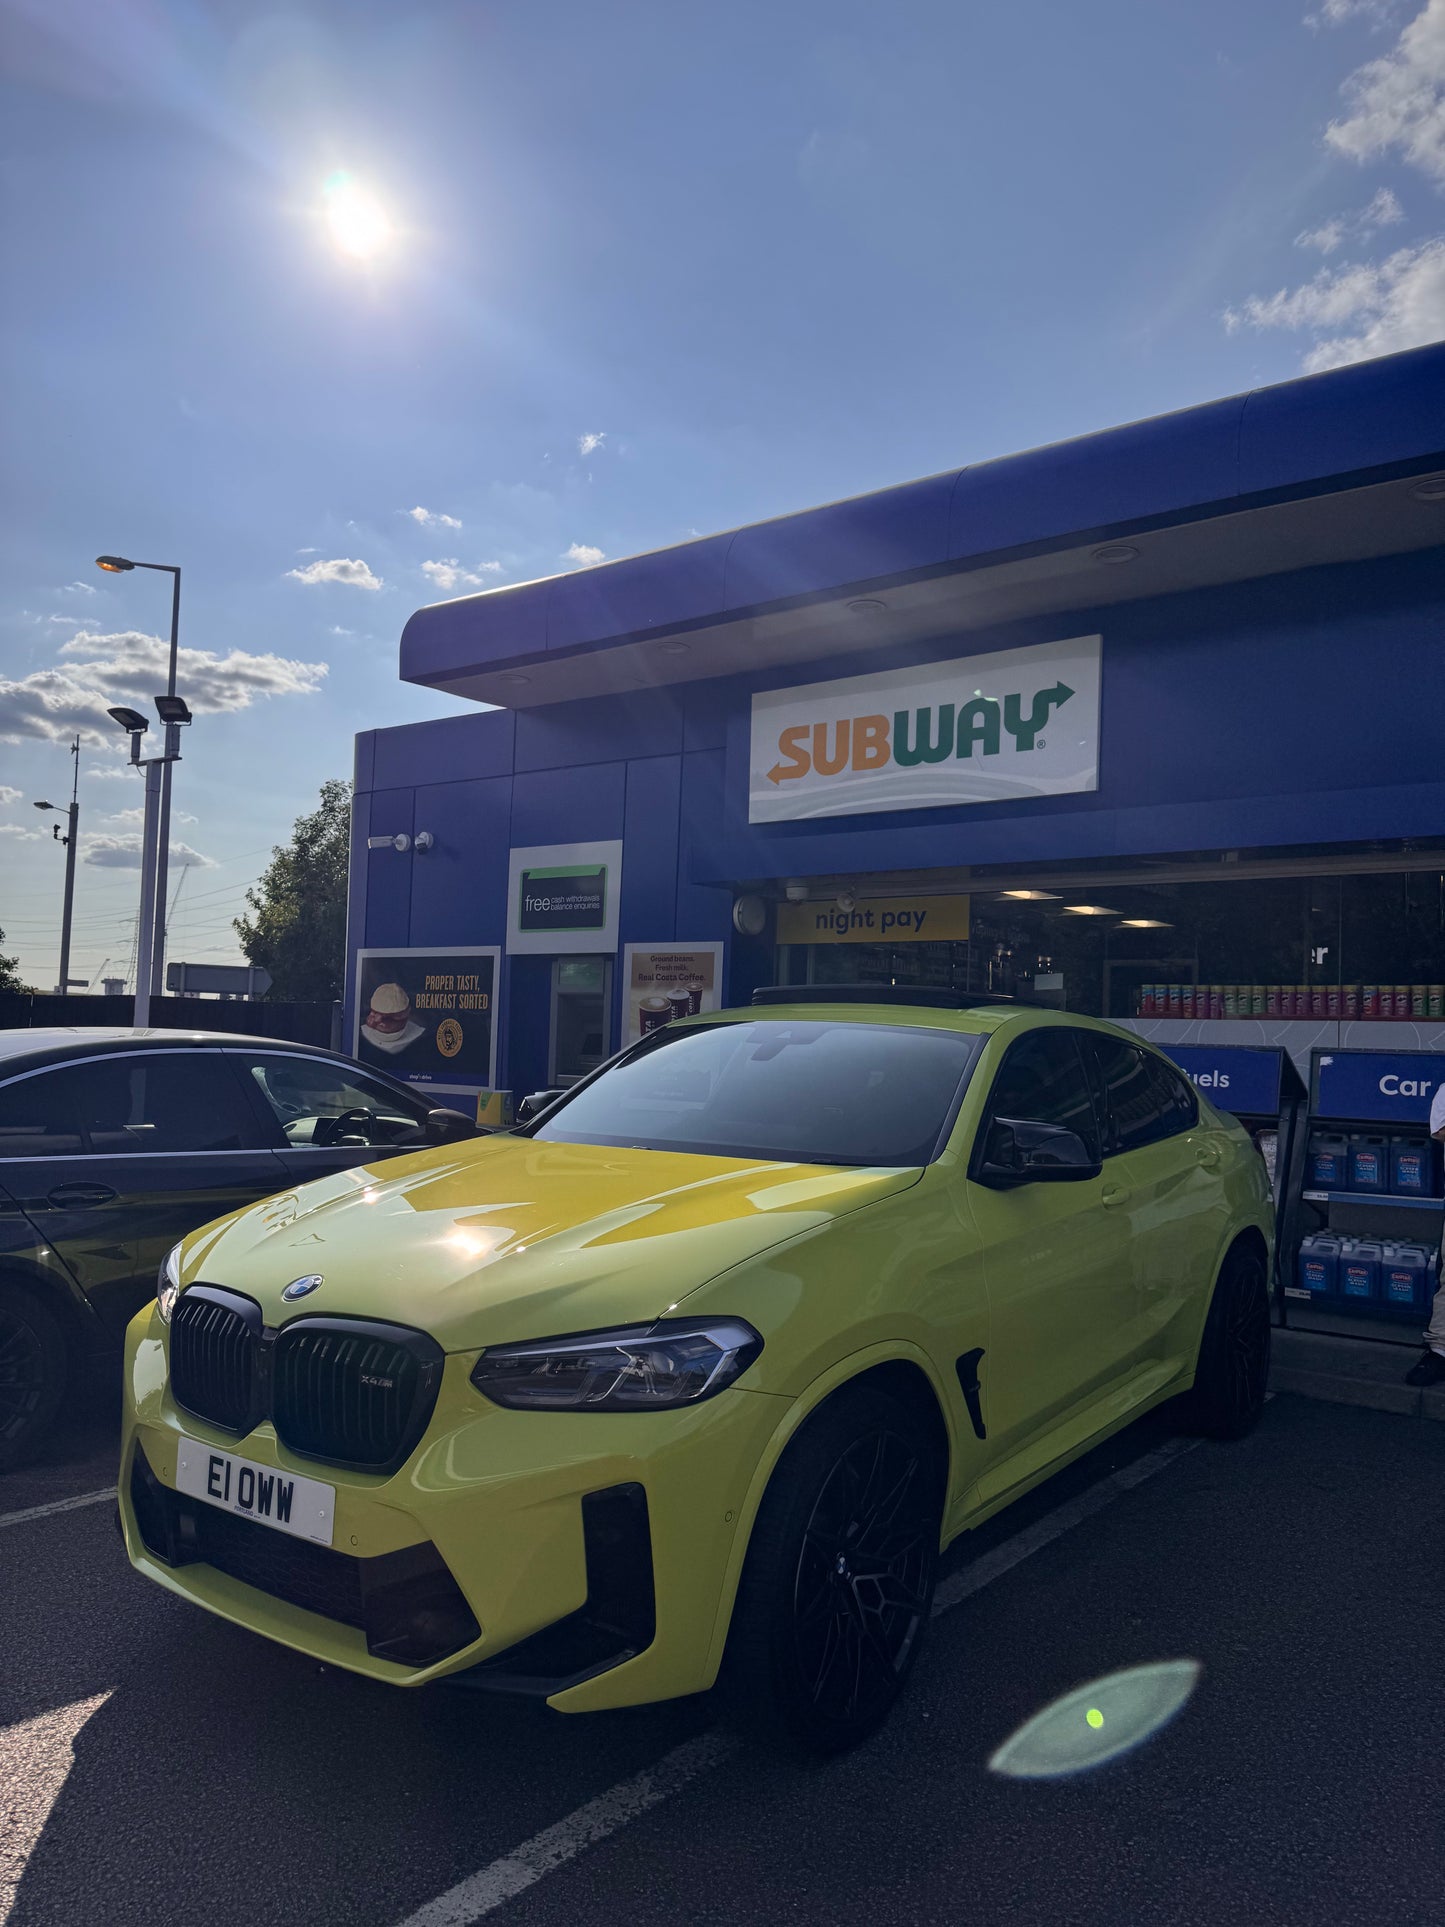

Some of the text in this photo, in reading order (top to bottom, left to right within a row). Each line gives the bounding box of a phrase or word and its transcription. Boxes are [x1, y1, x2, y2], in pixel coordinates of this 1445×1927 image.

[767, 681, 1076, 785] SUBWAY
[525, 895, 551, 911] free
[551, 902, 600, 911] balance enquiries
[565, 895, 600, 903] withdrawals
[816, 909, 927, 934] night pay
[425, 975, 480, 992] PROPER TASTY,
[639, 973, 654, 981] Real
[656, 973, 677, 981] Costa
[416, 993, 488, 1009] BREAKFAST SORTED
[1379, 1074, 1432, 1097] Car
